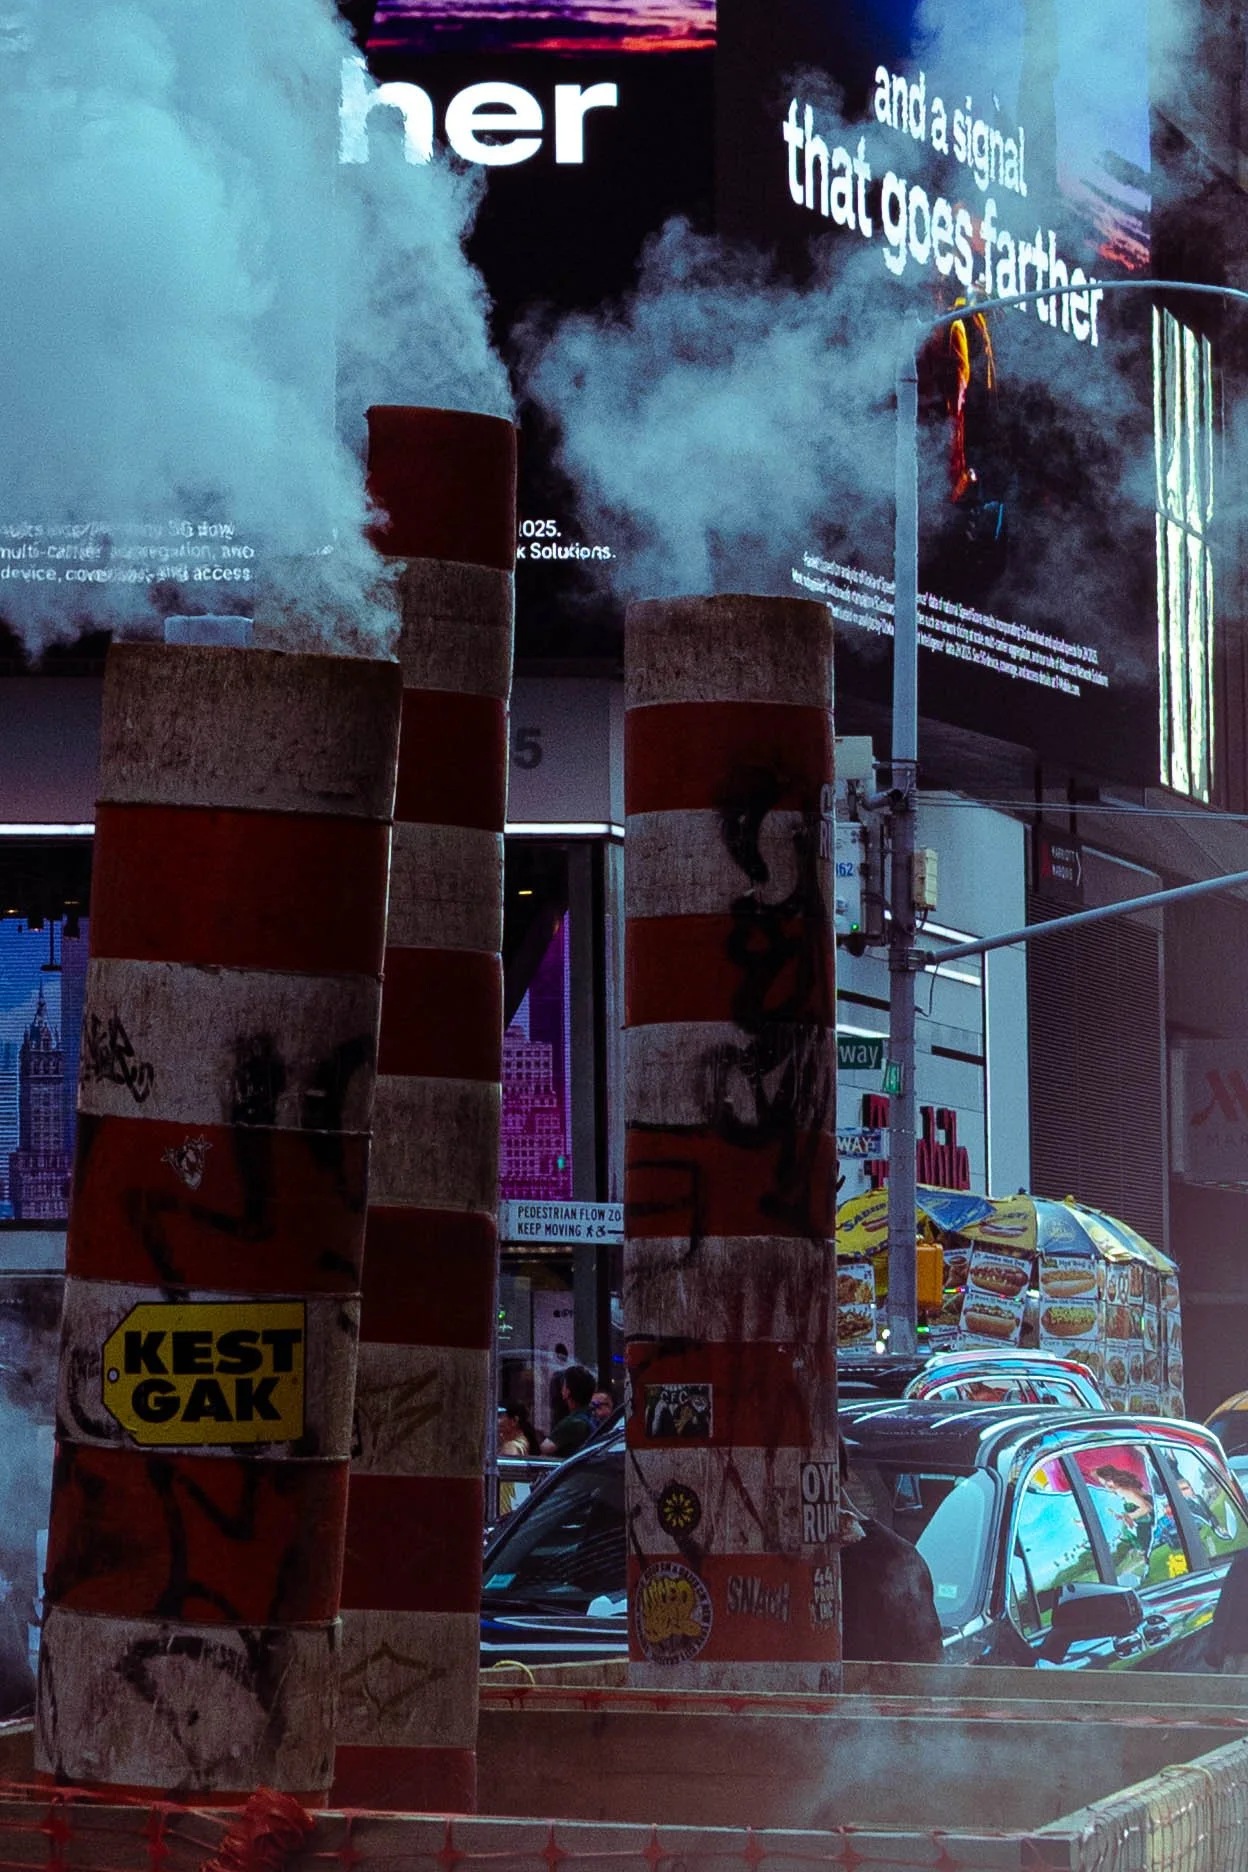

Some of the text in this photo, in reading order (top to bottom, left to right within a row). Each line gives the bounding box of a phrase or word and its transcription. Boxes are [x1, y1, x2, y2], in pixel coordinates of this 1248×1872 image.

[874, 64, 1027, 197] and a signal
[783, 98, 1104, 347] that goes farther
[517, 1206, 622, 1222] PEDESTRIAN FLOW ZO
[517, 1223, 582, 1237] KEEP MOVING
[124, 1329, 303, 1376] KEST
[131, 1377, 282, 1423] GAK
